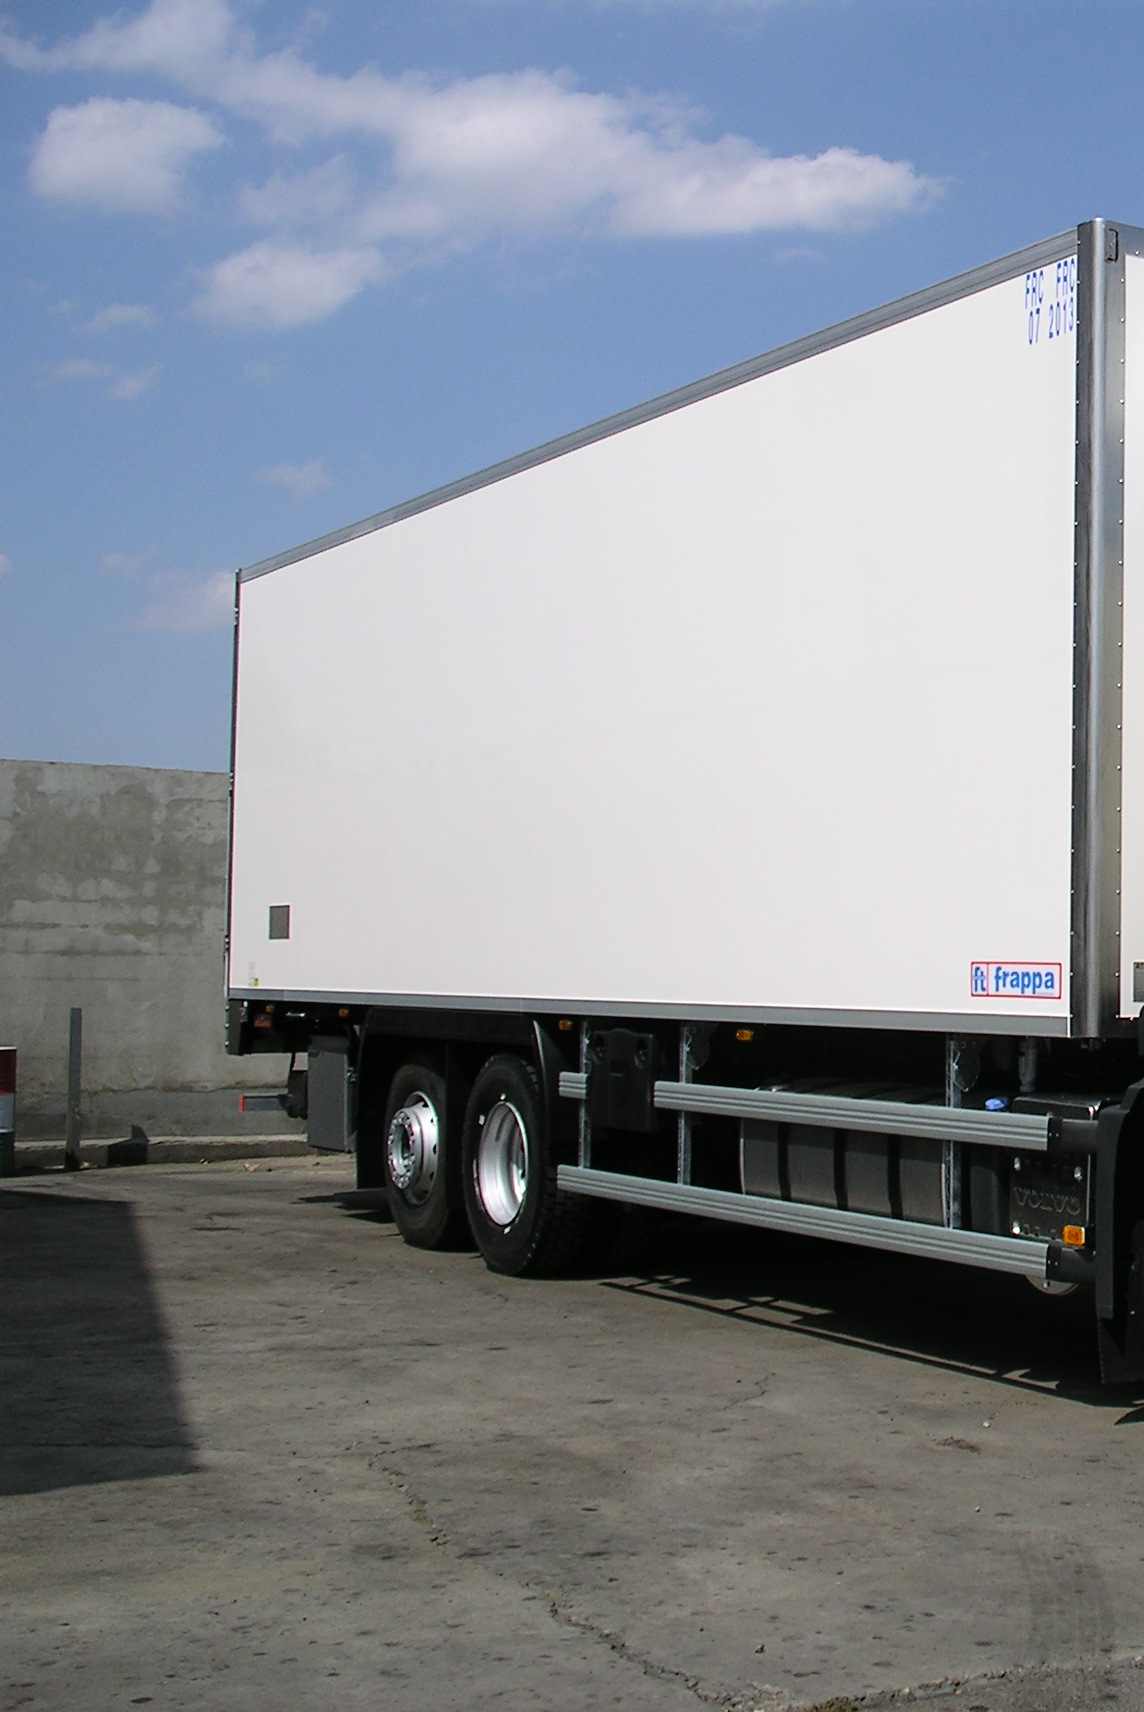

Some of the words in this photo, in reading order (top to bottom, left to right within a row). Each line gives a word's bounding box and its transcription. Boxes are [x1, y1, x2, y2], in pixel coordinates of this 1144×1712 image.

[1025, 269, 1044, 310] FRC
[1055, 257, 1076, 299] FRC
[1028, 307, 1041, 345] 07
[1048, 296, 1075, 339] 2013
[994, 966, 1055, 995] frappa
[1013, 1187, 1081, 1214] VOLVO
